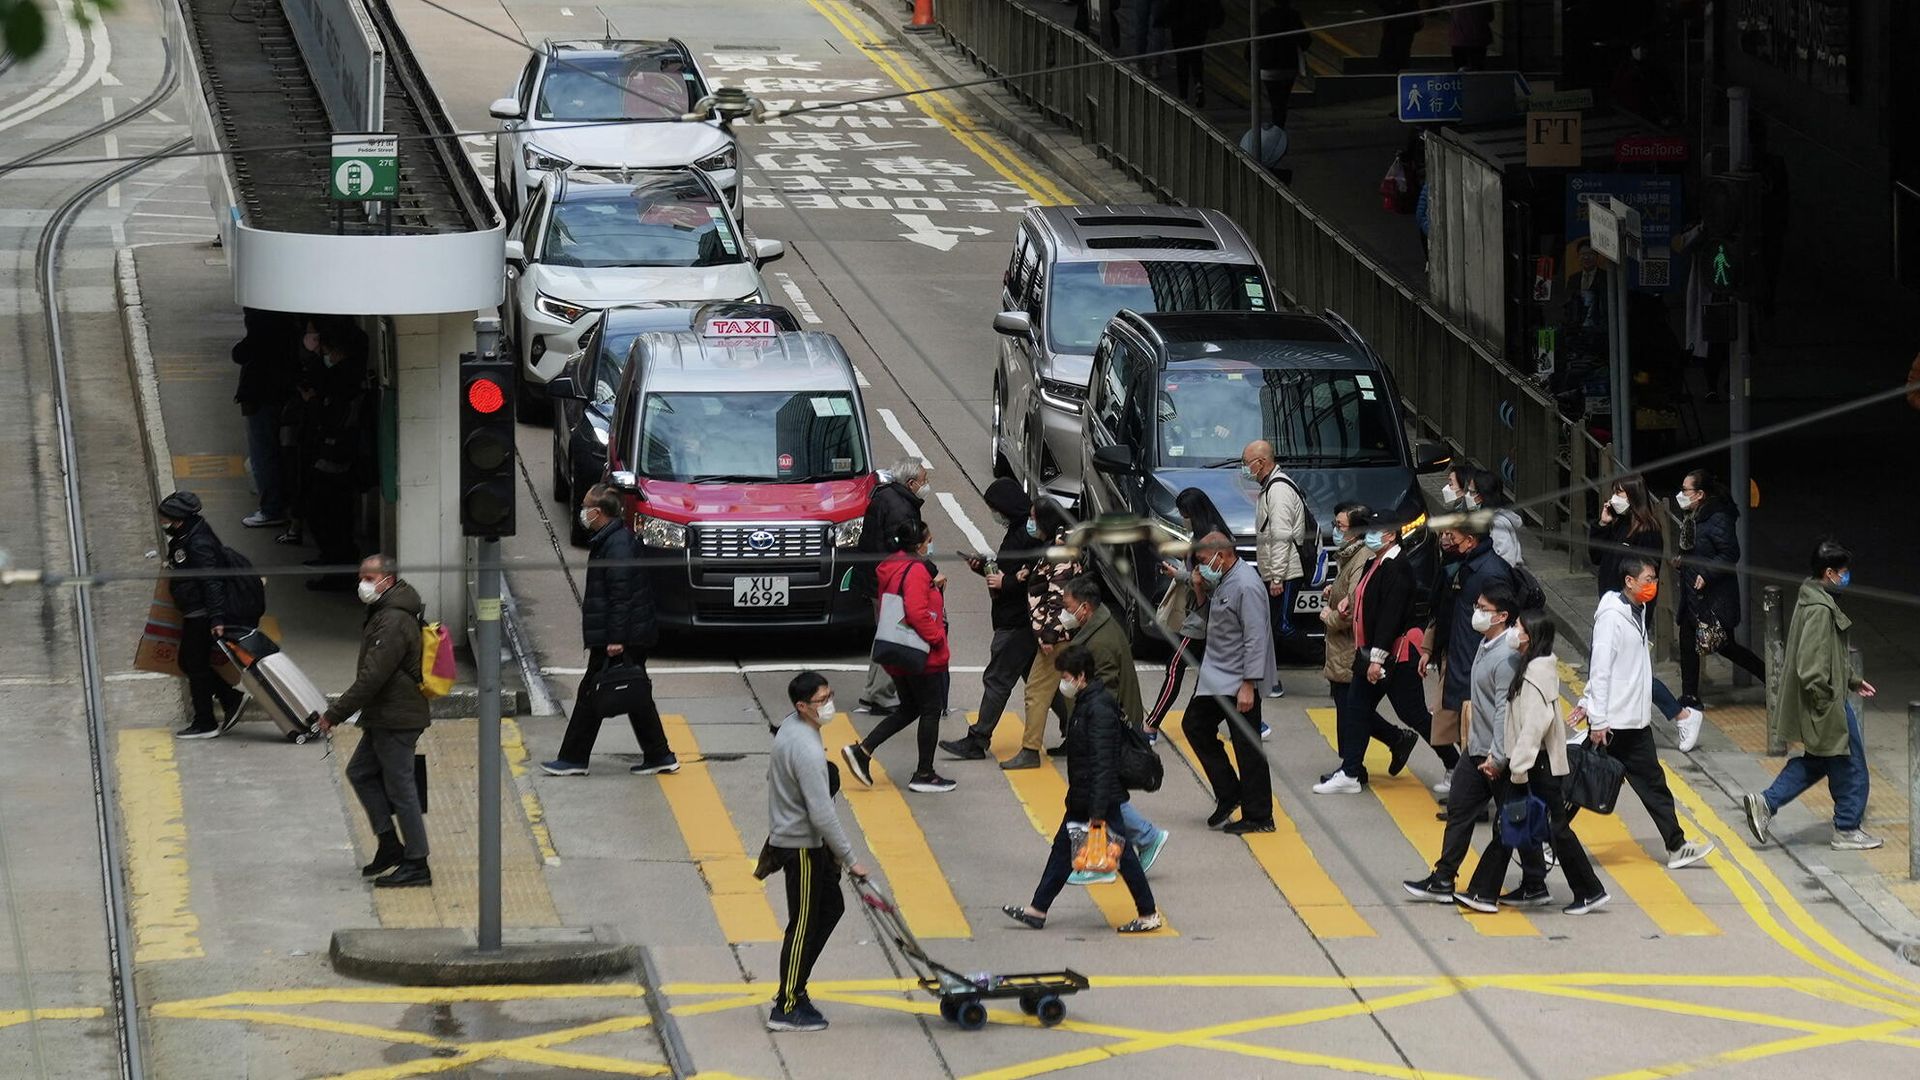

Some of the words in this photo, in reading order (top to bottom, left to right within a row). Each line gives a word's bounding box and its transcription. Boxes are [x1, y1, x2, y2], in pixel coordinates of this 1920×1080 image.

[1428, 80, 1463, 90] Footb
[761, 99, 907, 113] ROA
[1430, 97, 1462, 112] 行人
[733, 115, 946, 129] CHAT
[1532, 119, 1578, 145] FT
[713, 321, 769, 334] TAXI
[751, 578, 773, 591] XU
[738, 591, 785, 605] 4692
